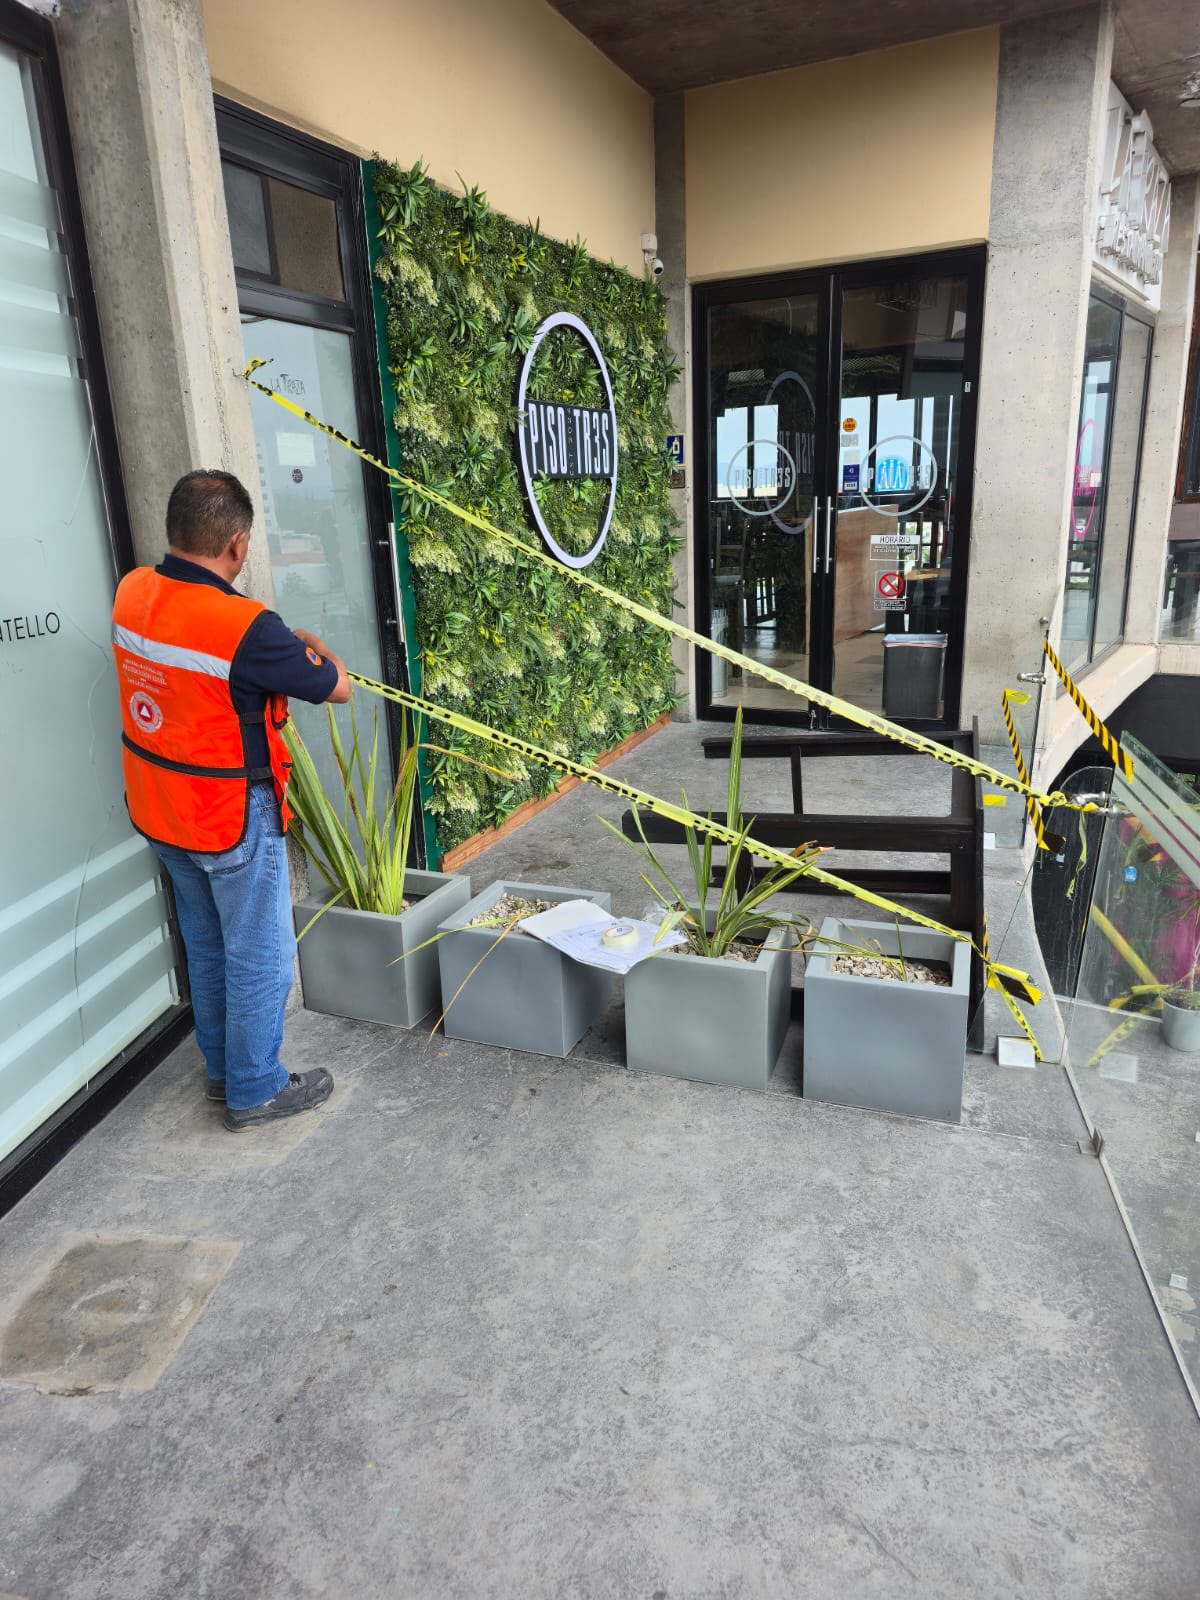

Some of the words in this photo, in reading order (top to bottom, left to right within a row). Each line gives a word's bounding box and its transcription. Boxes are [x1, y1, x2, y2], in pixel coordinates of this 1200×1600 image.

[528, 402, 568, 475] PISO
[573, 408, 610, 475] TR3S
[879, 535, 911, 544] HORARIO
[0, 611, 60, 643] TELLO
